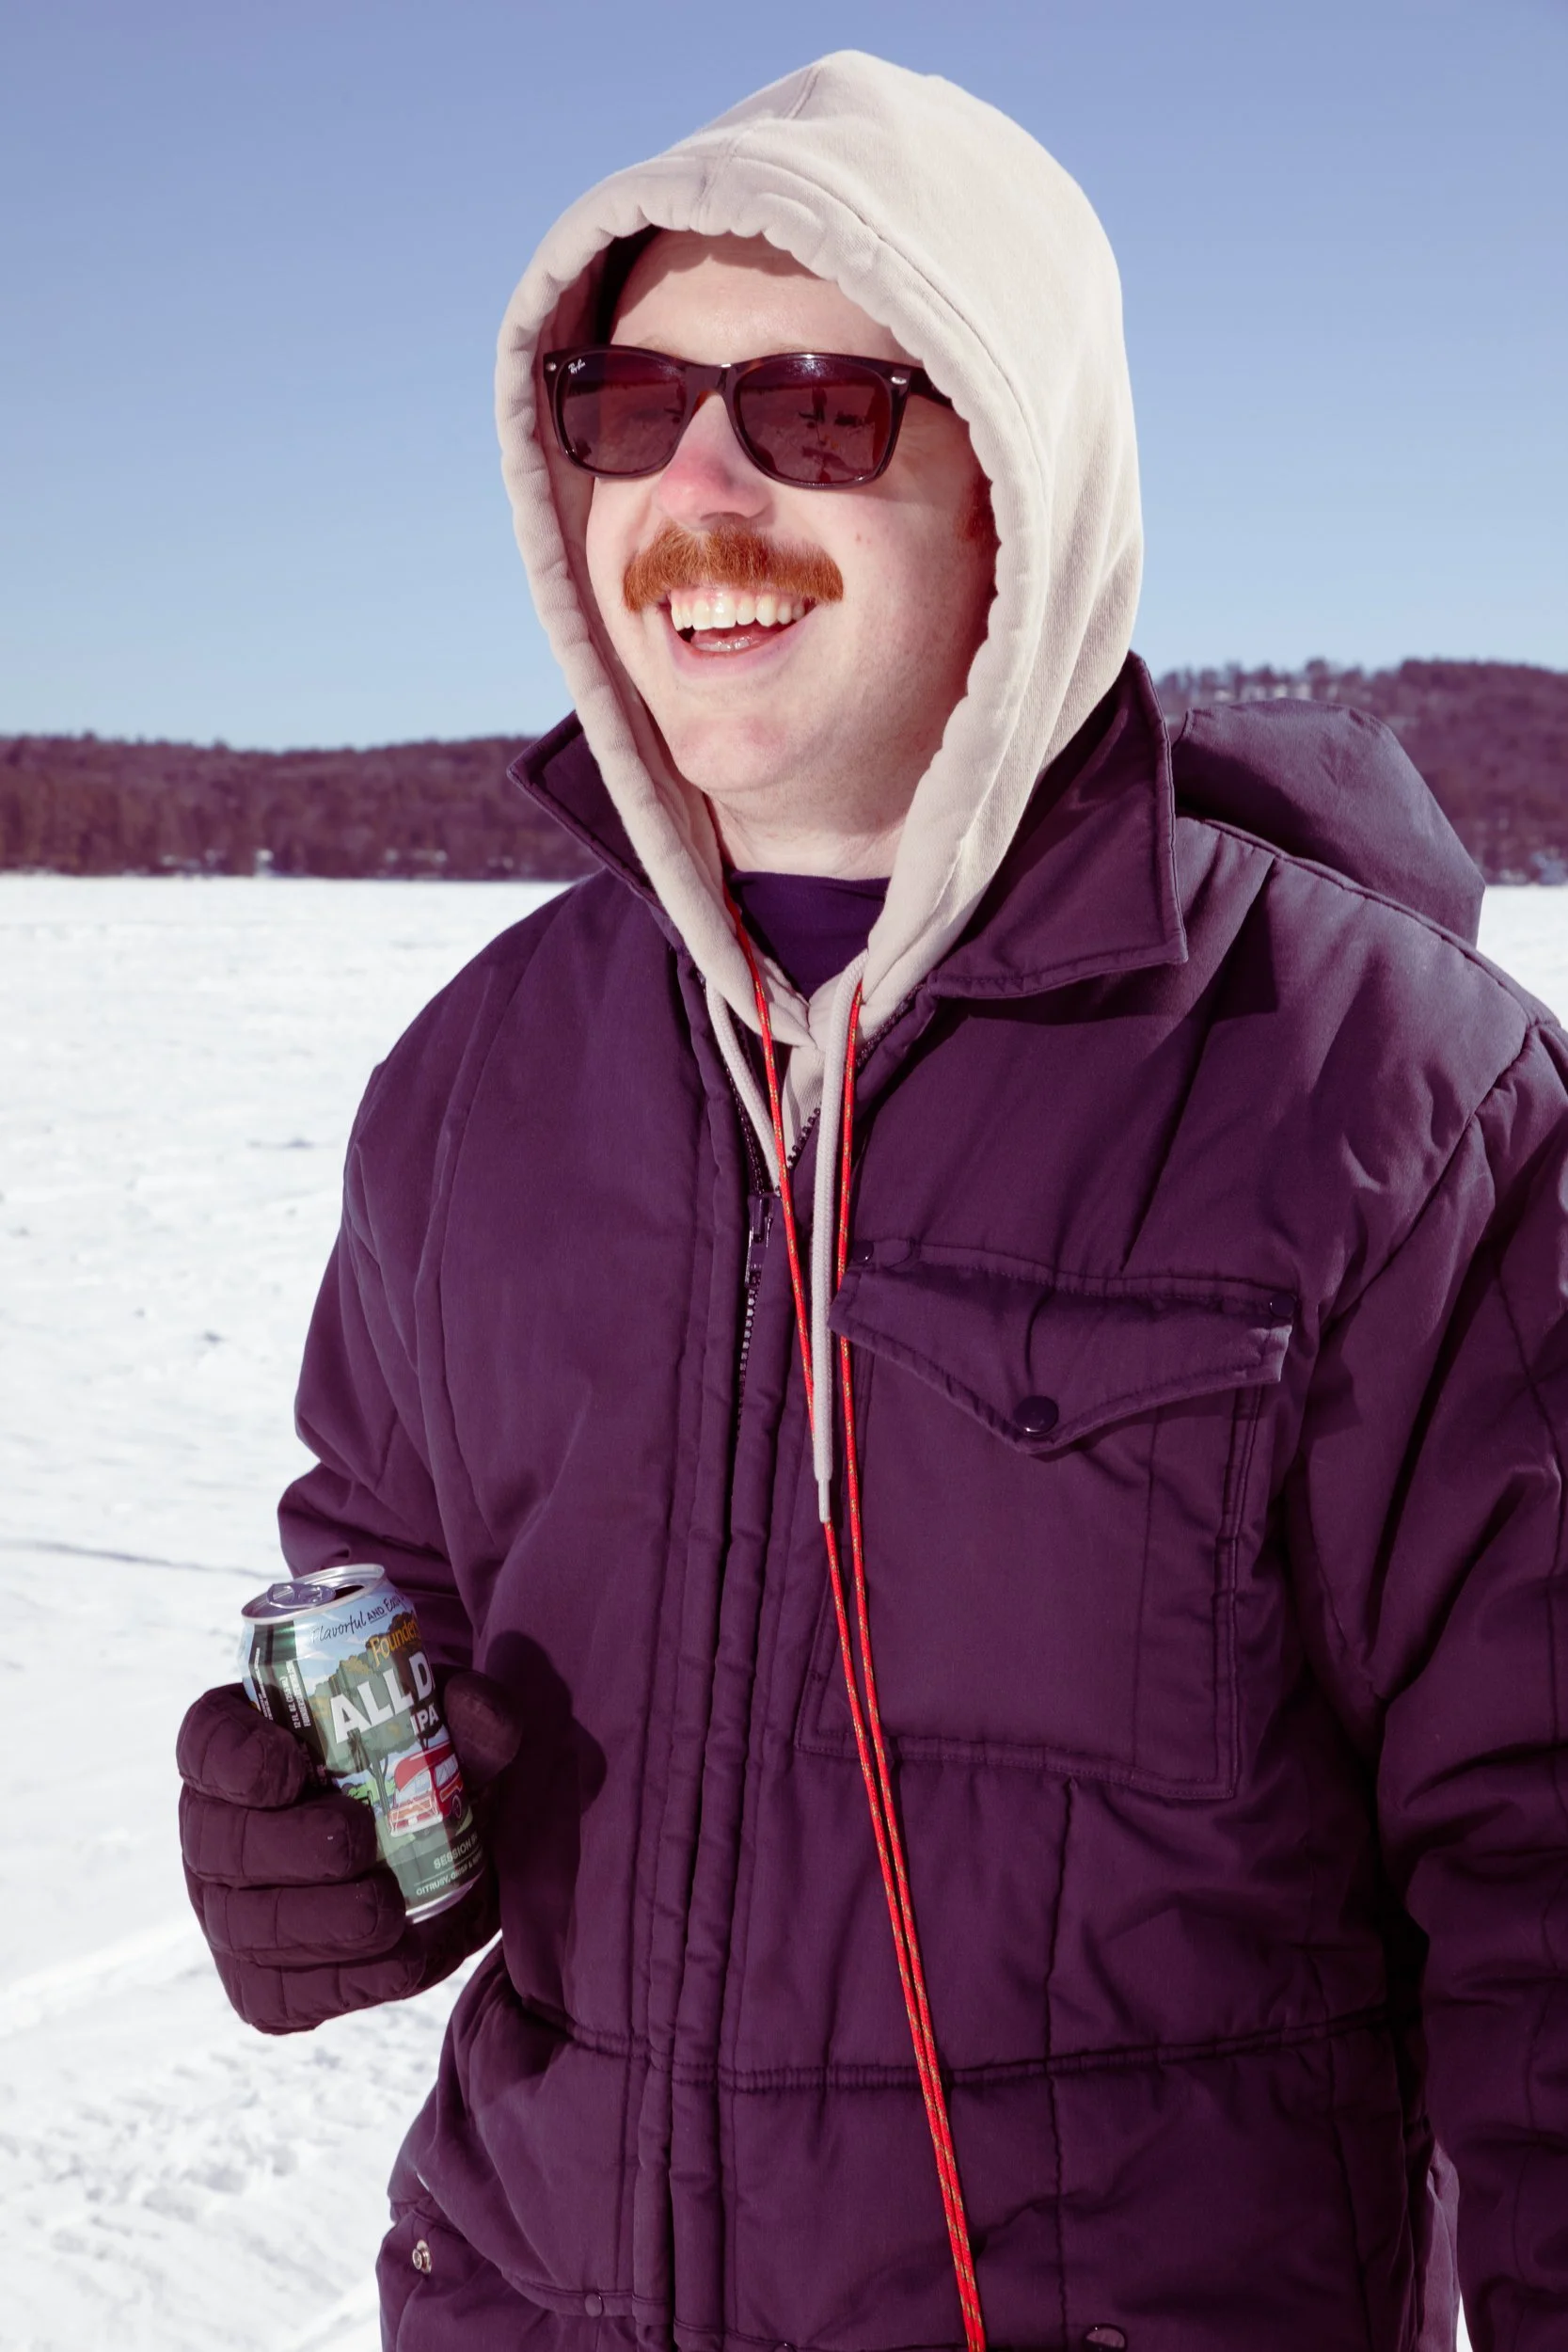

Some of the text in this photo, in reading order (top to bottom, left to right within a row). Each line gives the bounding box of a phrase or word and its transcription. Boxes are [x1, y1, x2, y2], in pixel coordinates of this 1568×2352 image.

[311, 1611, 367, 1644] Flavorful
[367, 1607, 386, 1621] AND
[330, 1668, 414, 1744] ALL
[408, 1651, 436, 1701] D
[410, 1703, 439, 1736] IPA
[434, 1837, 472, 1869] SESSION
